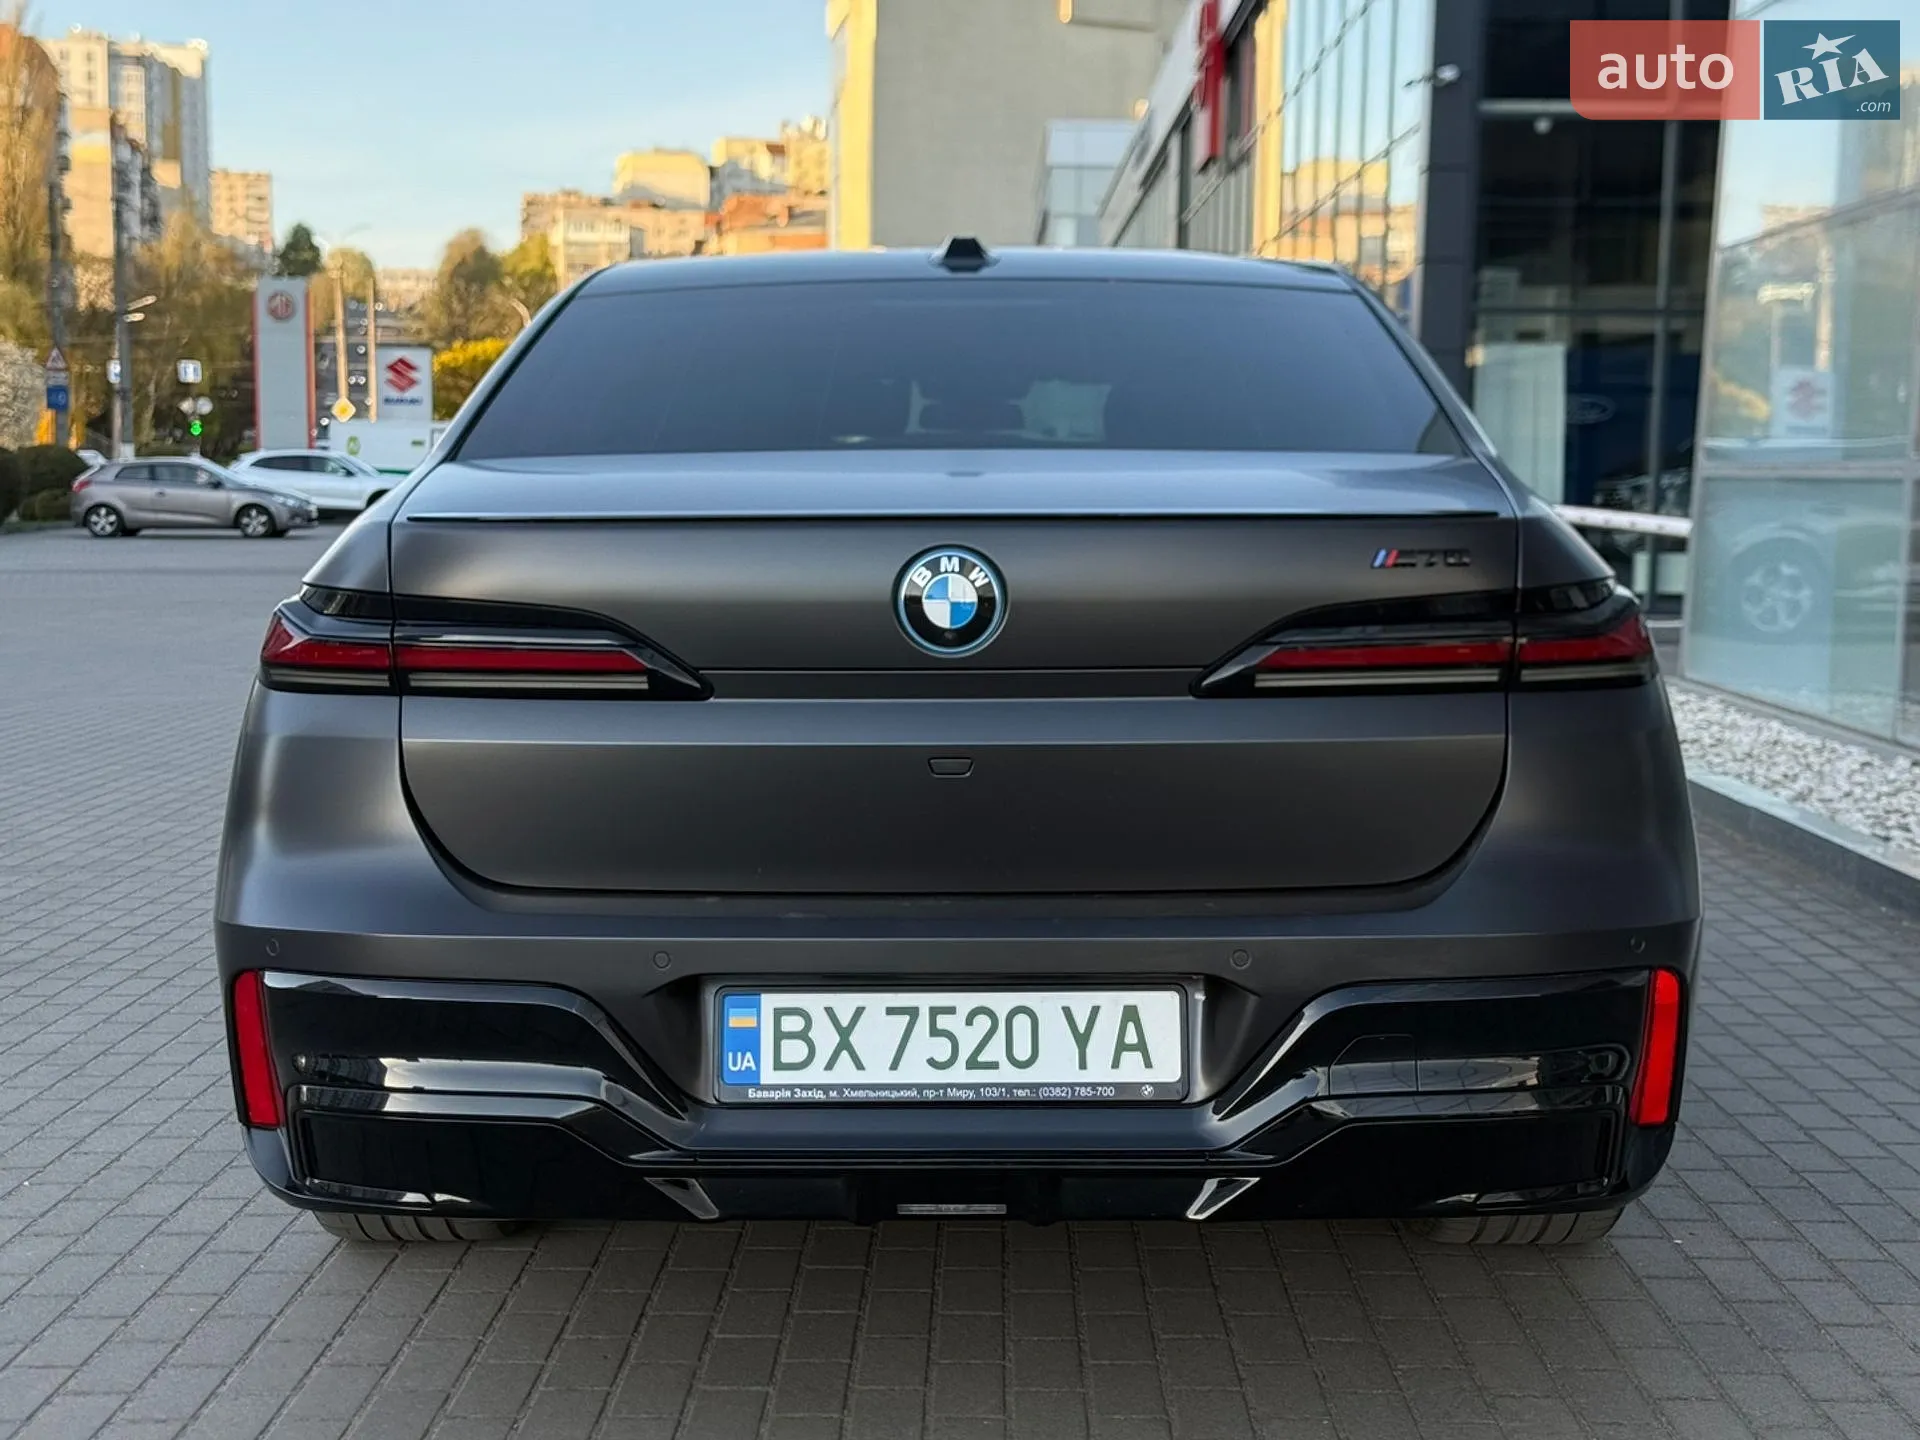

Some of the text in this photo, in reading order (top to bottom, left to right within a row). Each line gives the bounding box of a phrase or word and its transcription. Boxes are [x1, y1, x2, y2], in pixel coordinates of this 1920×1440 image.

[911, 556, 989, 588] BMW
[773, 1005, 1154, 1072] BX 7520 YA
[728, 1051, 756, 1072] UA
[748, 1088, 791, 1099] Баварія
[793, 1088, 826, 1099] Захід,
[843, 1087, 920, 1099] Хмельницький,
[922, 1090, 944, 1099] пр-т
[947, 1087, 976, 1099] Миру,
[980, 1087, 1010, 1098] 103/1,
[1012, 1089, 1036, 1097] тел.:
[1039, 1086, 1072, 1099] (0382)
[1074, 1086, 1115, 1097] 785-700
